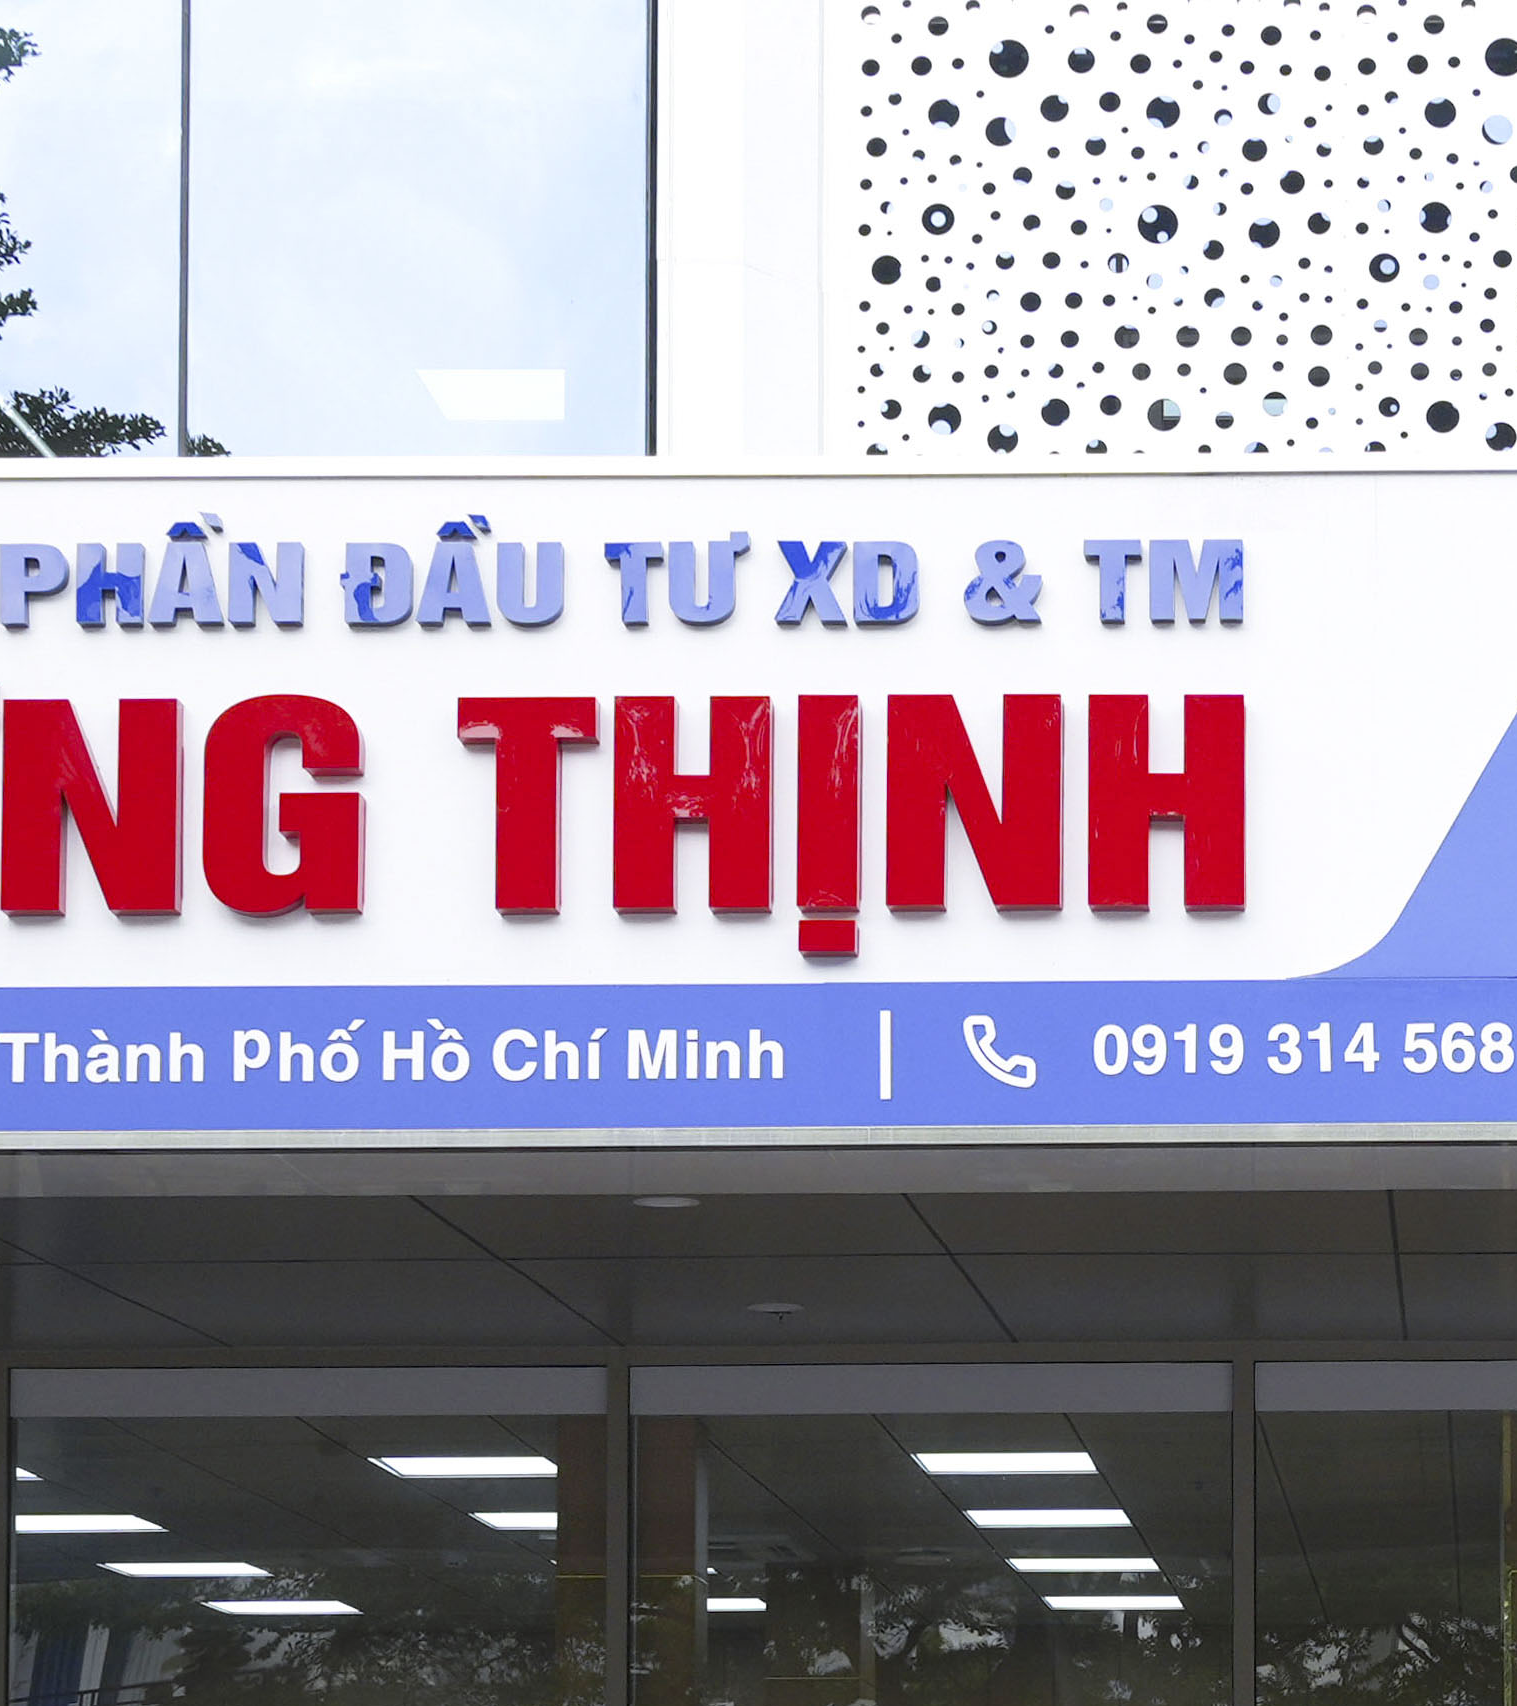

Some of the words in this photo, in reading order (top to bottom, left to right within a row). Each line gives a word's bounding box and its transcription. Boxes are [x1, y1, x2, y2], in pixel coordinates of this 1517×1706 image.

[0, 516, 304, 629] PHẦN
[340, 514, 564, 624] ĐẦU
[604, 532, 750, 624] TƯ
[774, 541, 919, 624] XD
[964, 541, 1042, 625] &
[1084, 540, 1243, 624] TM
[458, 694, 1246, 957] THỊNH
[0, 1030, 203, 1082] Thành
[234, 1020, 364, 1081] Phố
[383, 1019, 469, 1081] Hồ
[493, 1029, 607, 1081] Chí
[628, 1030, 783, 1078] Minh
[1094, 1024, 1243, 1075] 0919
[1268, 1023, 1379, 1073] 314
[1404, 1023, 1514, 1073] 568
